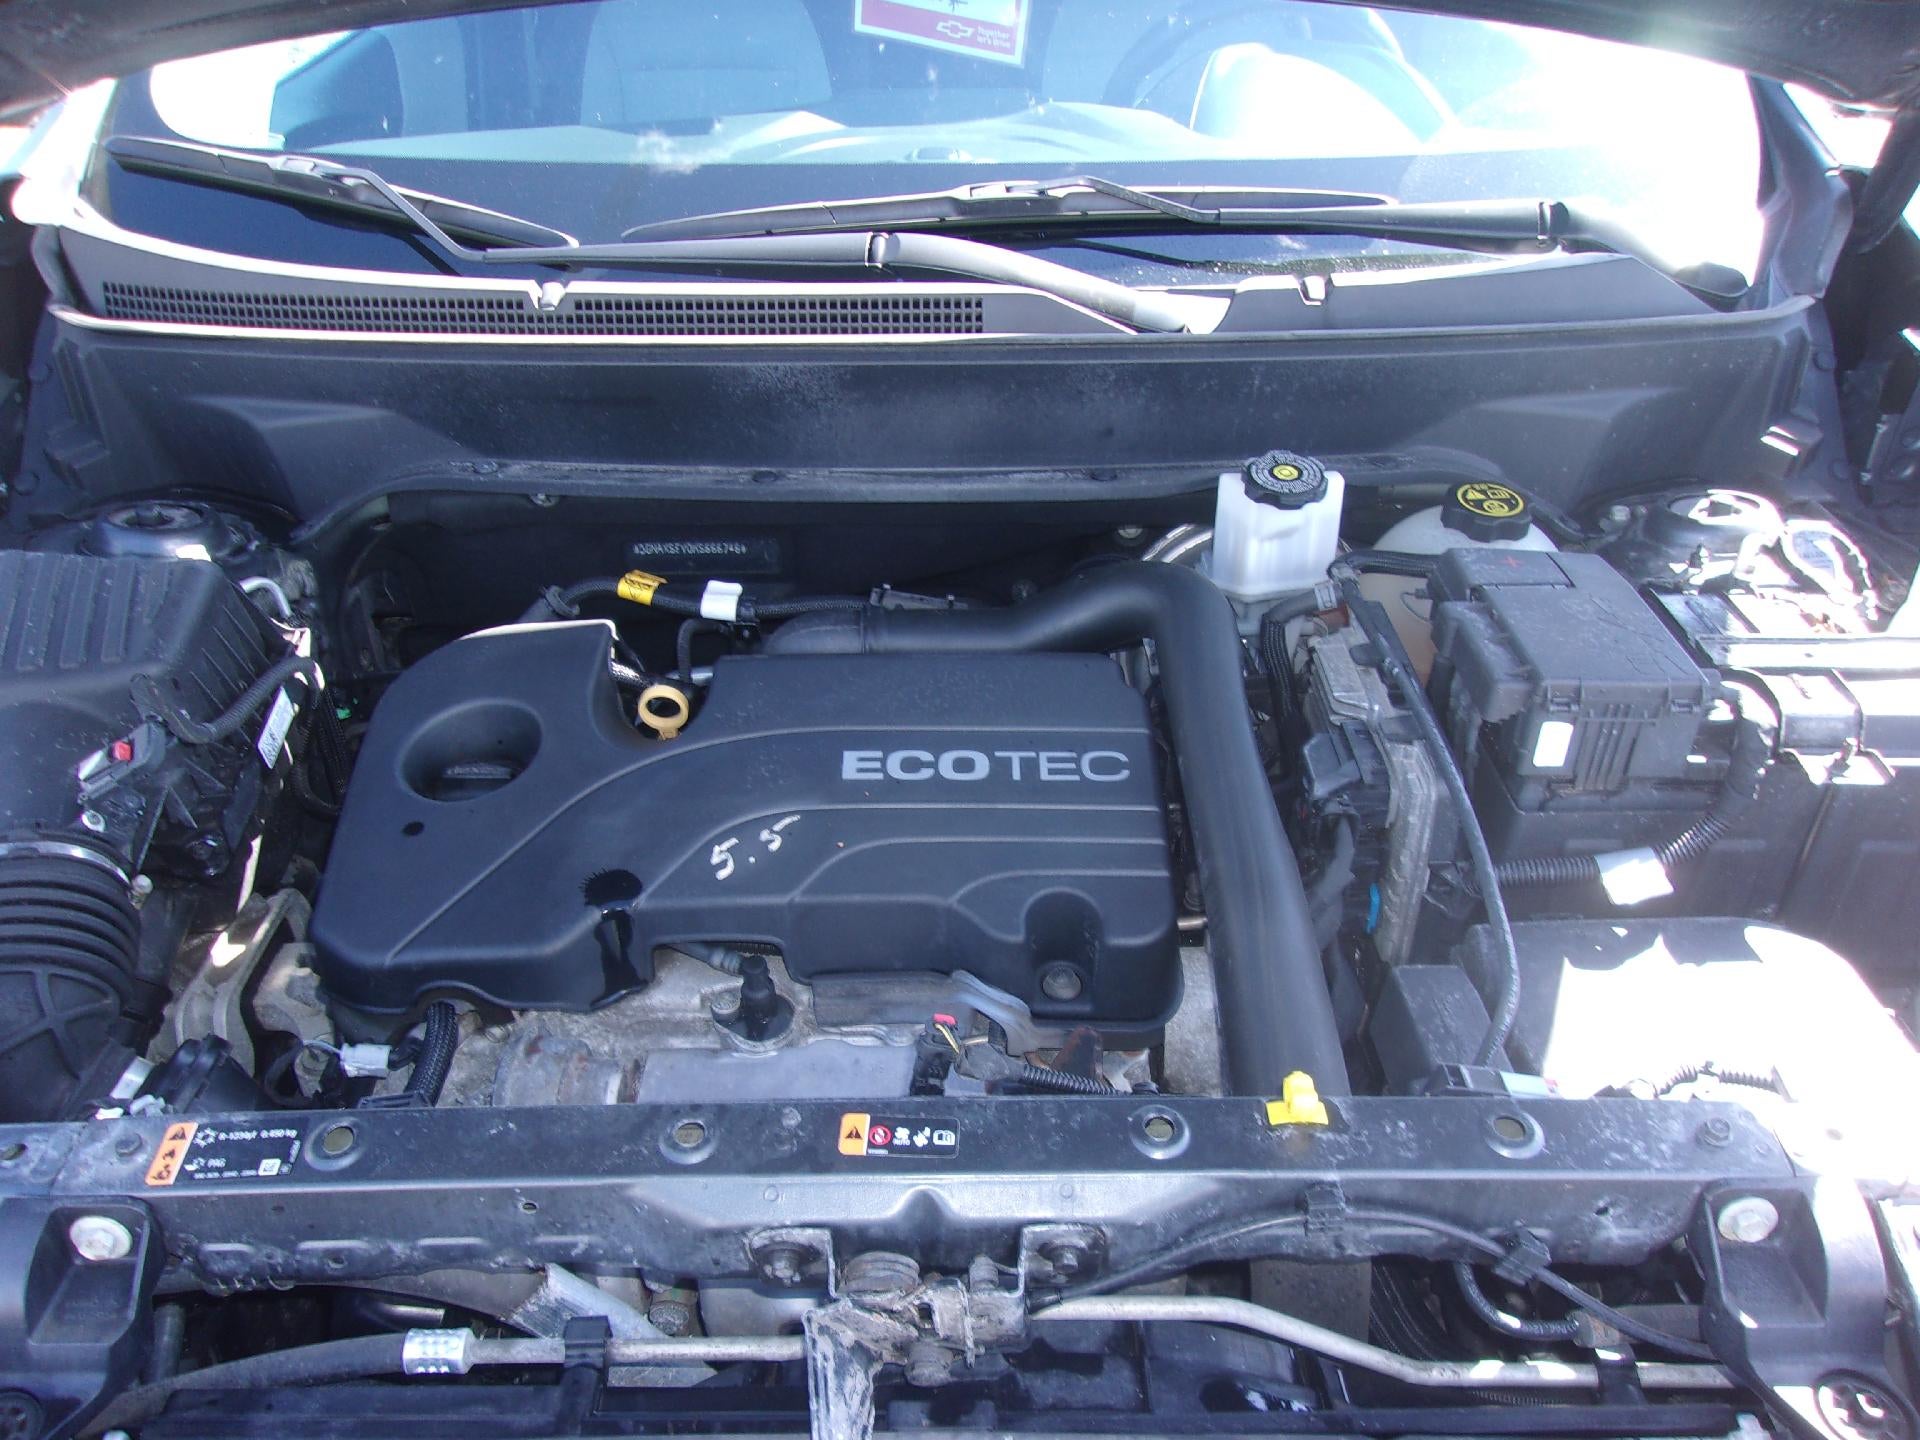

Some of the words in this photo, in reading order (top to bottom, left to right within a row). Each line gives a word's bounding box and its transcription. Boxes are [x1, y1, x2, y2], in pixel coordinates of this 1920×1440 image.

[842, 750, 1129, 782] ECOTEC
[710, 814, 801, 881] 5.5
[893, 1138, 910, 1146] AUTO
